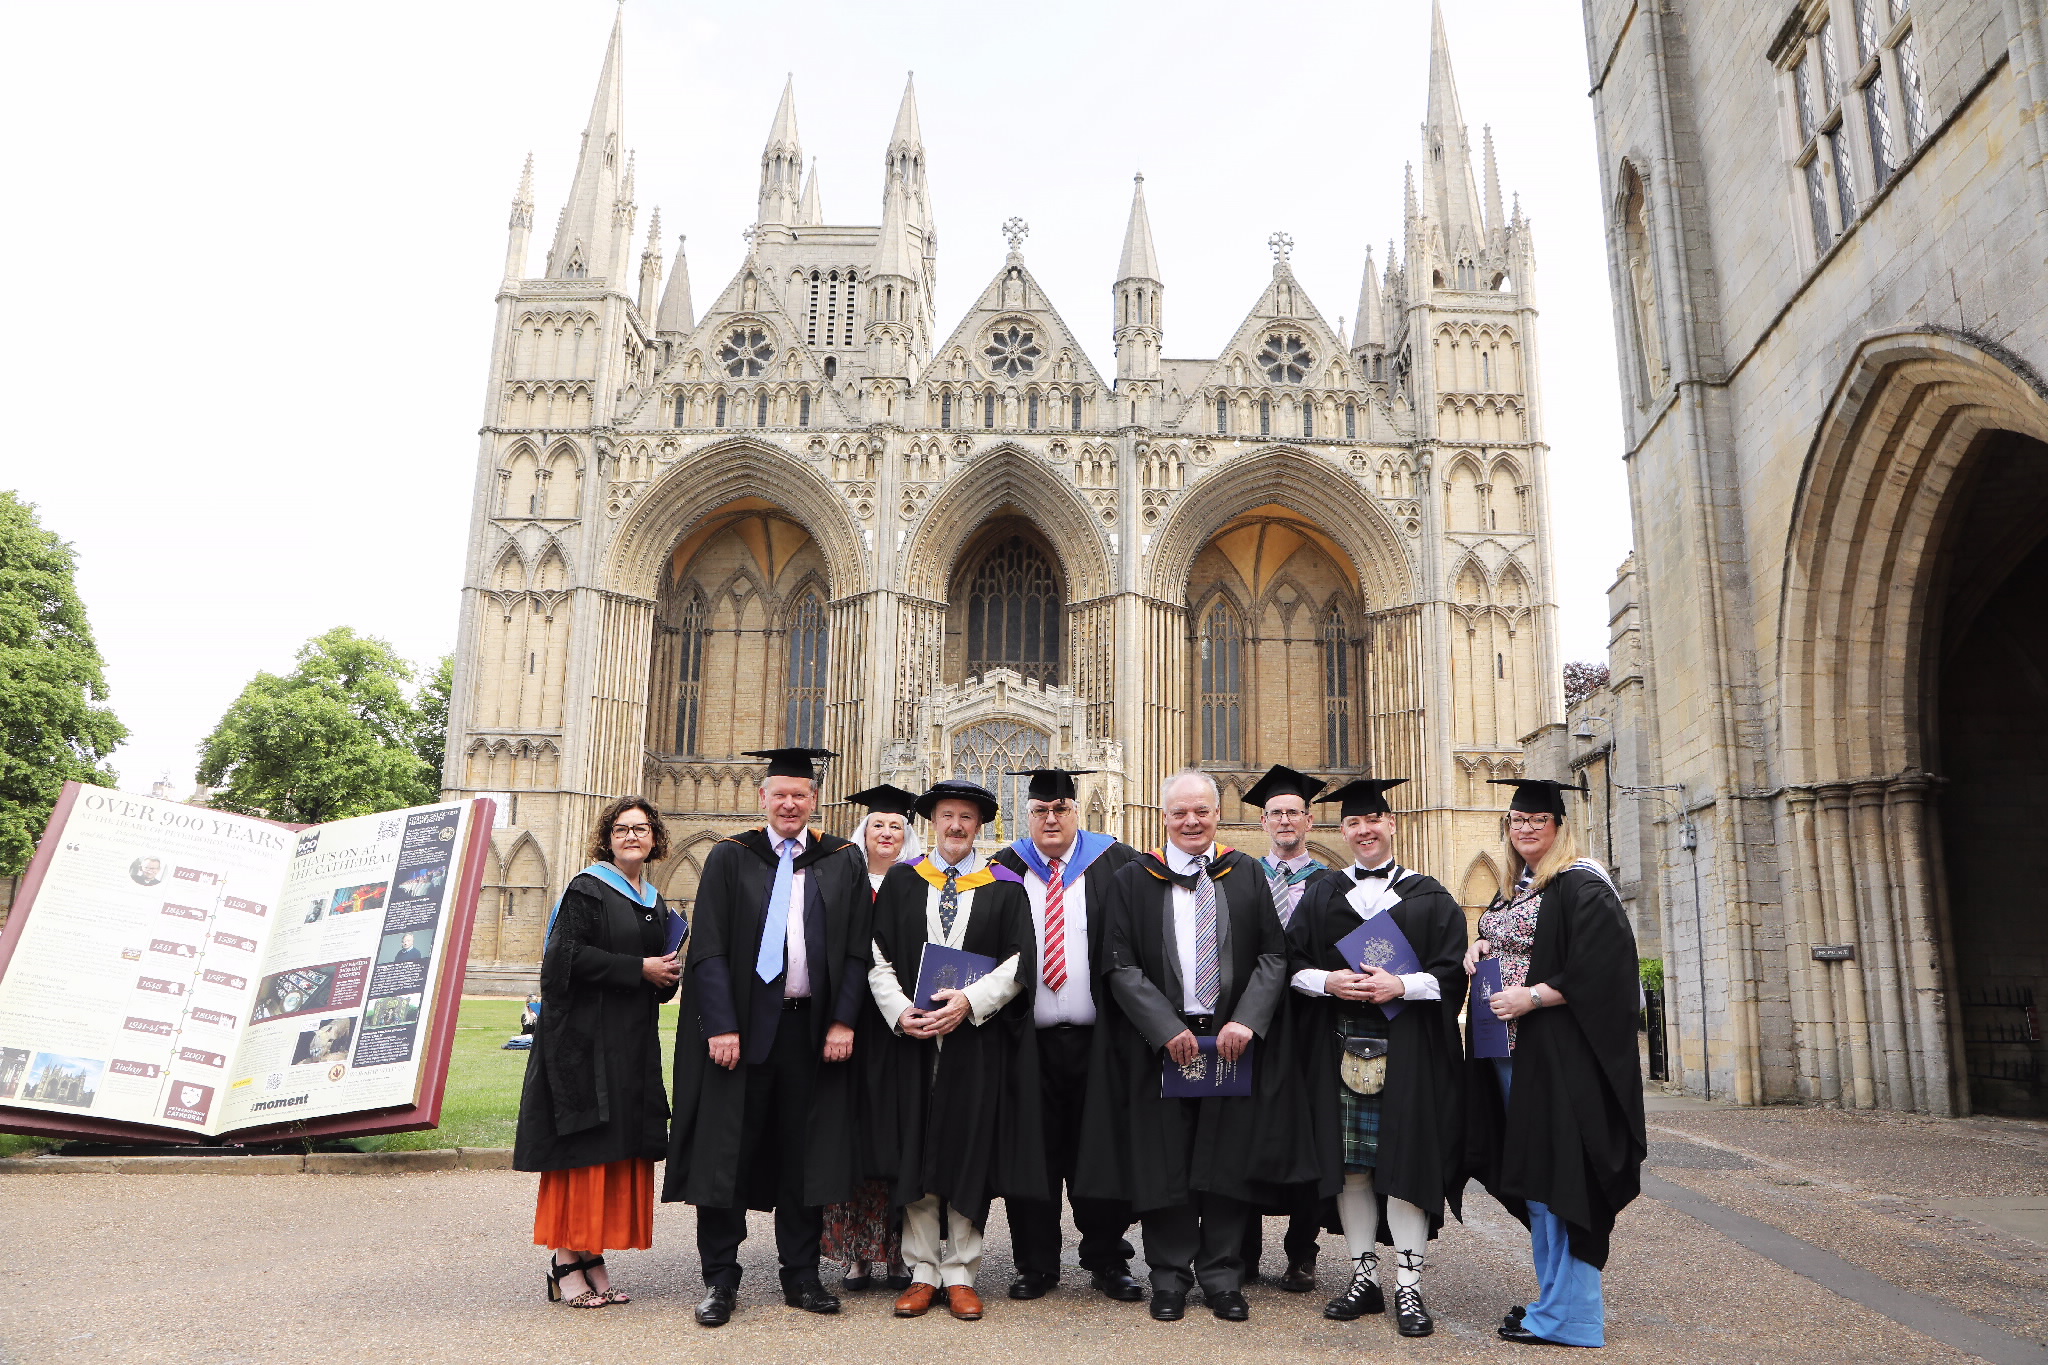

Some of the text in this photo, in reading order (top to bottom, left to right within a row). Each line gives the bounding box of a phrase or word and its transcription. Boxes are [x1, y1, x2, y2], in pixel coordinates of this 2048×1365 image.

[85, 794, 285, 851] OVER 900 YEARS
[297, 840, 317, 853] 900
[293, 844, 380, 871] WHAT'S ON AT
[290, 866, 313, 882] THE
[315, 853, 395, 875] CATHEDRAL
[183, 1051, 206, 1062] 2001
[115, 1062, 142, 1075] Today
[254, 1093, 309, 1112] moment
[166, 1111, 204, 1123] CATHEDRAL
